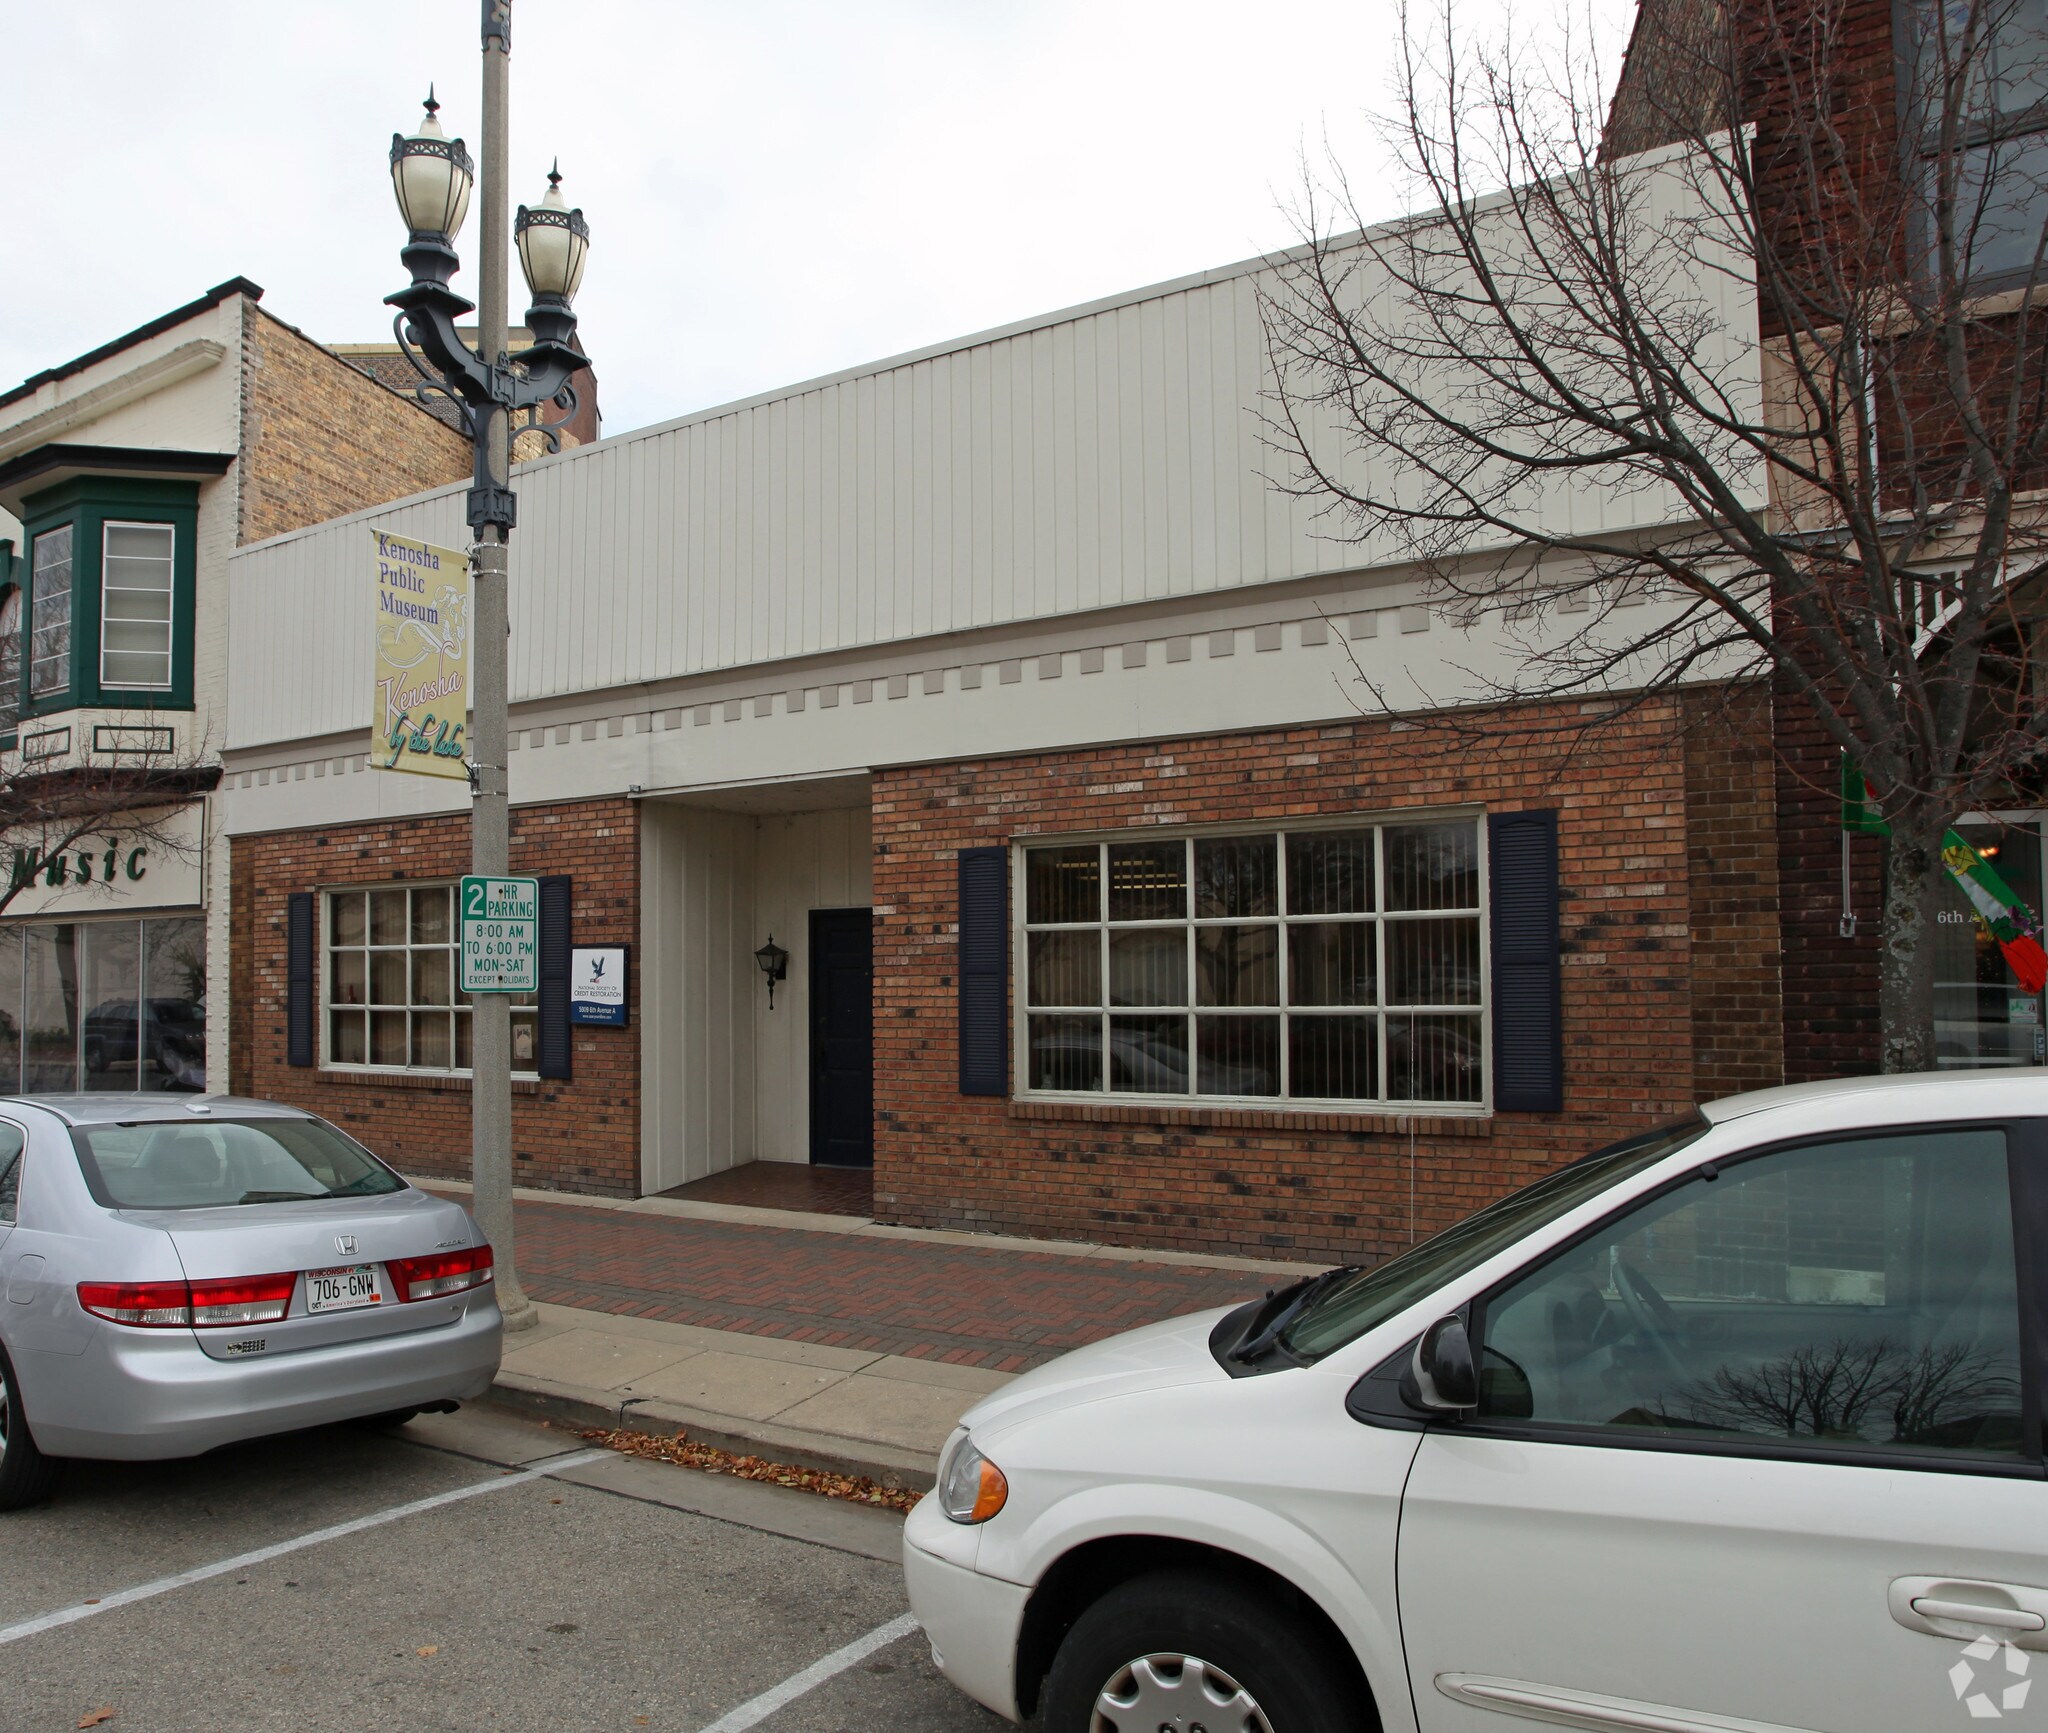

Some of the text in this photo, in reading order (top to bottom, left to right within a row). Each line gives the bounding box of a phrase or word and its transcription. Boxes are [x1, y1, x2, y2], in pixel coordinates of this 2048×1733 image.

[379, 534, 439, 570] Kenosha
[379, 562, 425, 593] Public
[380, 590, 438, 624] Museum
[377, 640, 464, 737] Kenosha
[384, 712, 463, 768] by the lake
[8, 837, 147, 889] Music
[467, 884, 518, 915] 2 HR
[488, 900, 533, 917] PARKING
[1937, 910, 1964, 924] 6th
[476, 924, 524, 938] 8:00 AM
[466, 941, 533, 955] TO 6:00 PM
[474, 958, 525, 972] MON-SAT
[469, 975, 495, 984] EXCEPT
[590, 990, 622, 998] RESTORATION
[308, 1267, 348, 1278] WISCONSIN
[314, 1274, 374, 1301] 706-GNW
[311, 1302, 323, 1310] OCT
